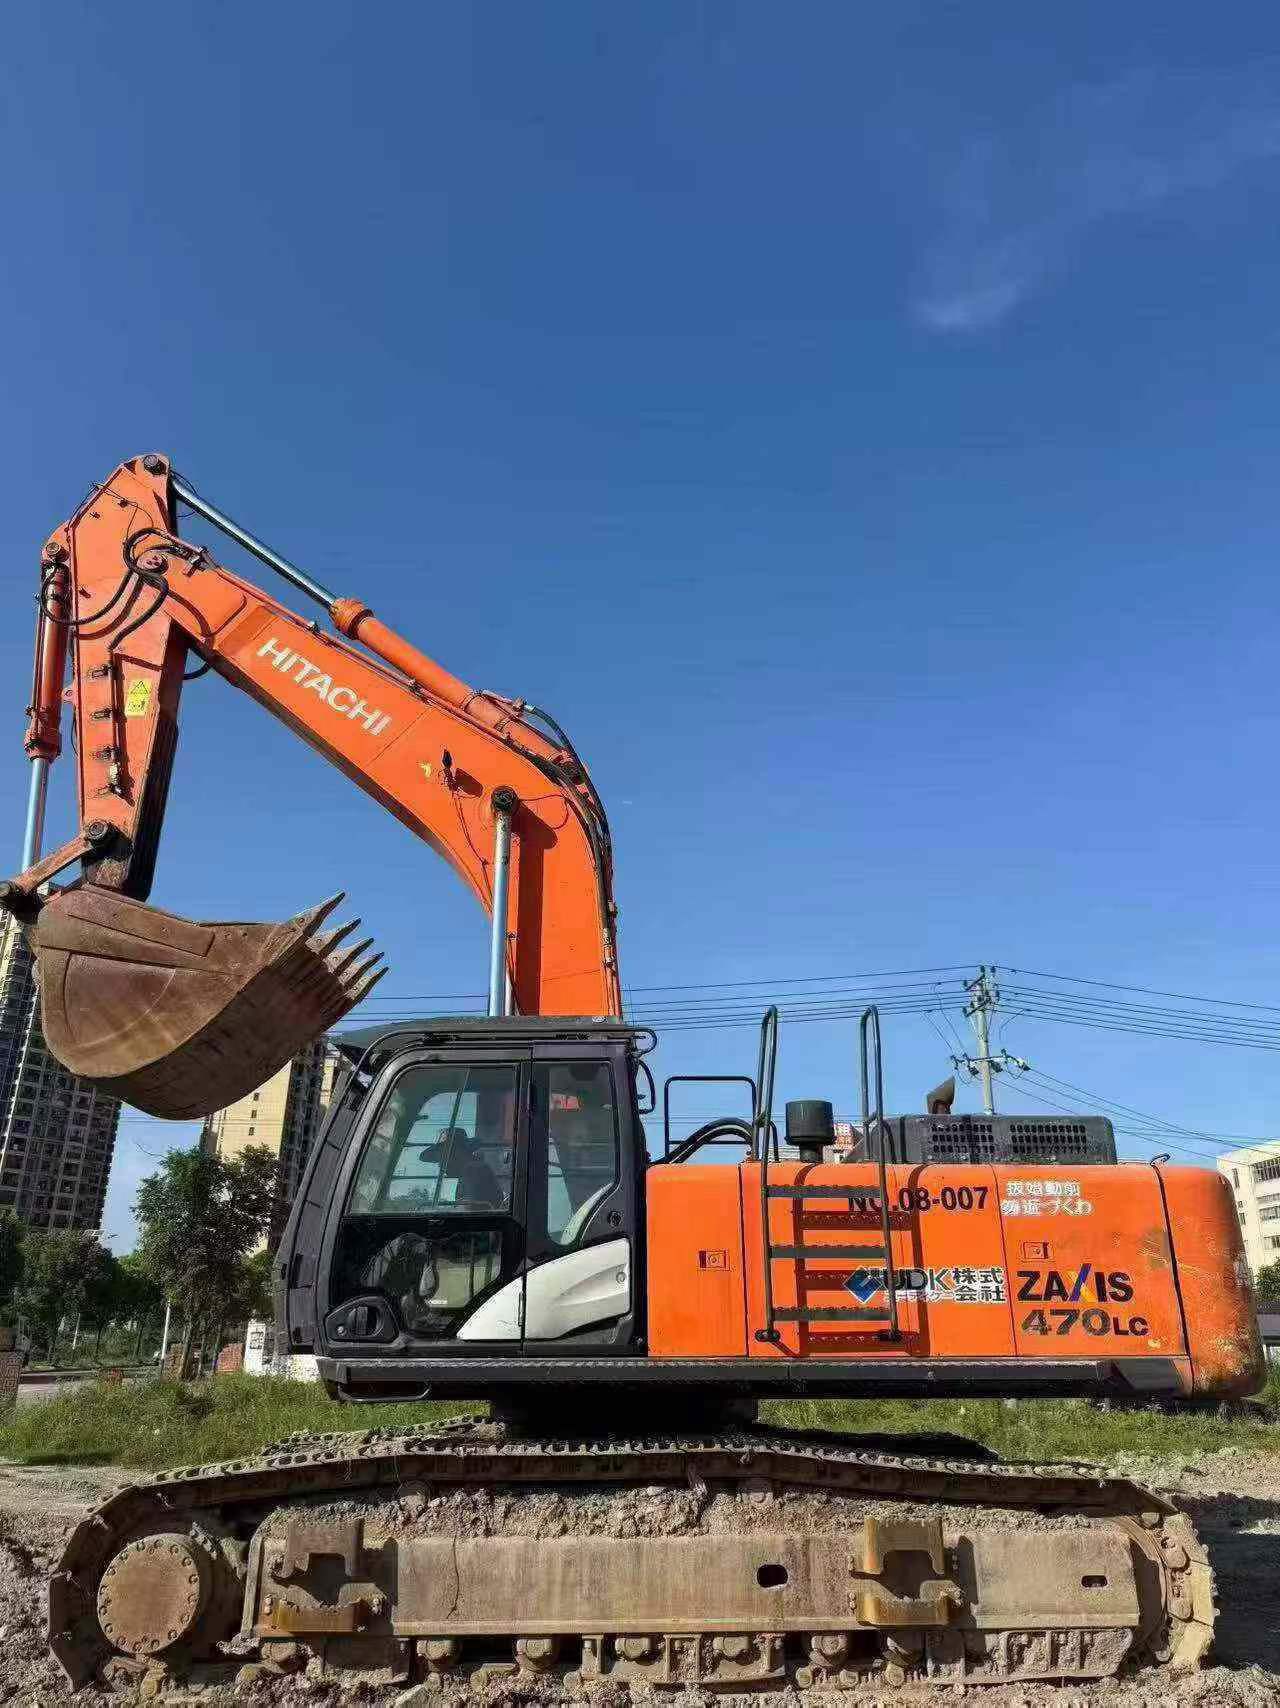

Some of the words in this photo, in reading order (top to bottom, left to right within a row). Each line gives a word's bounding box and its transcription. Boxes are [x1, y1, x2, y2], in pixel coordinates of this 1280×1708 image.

[256, 638, 392, 736] HITACHI
[953, 1267, 1003, 1285] 株式
[1017, 1264, 1134, 1303] ZAXIS
[955, 1285, 1005, 1302] 会社
